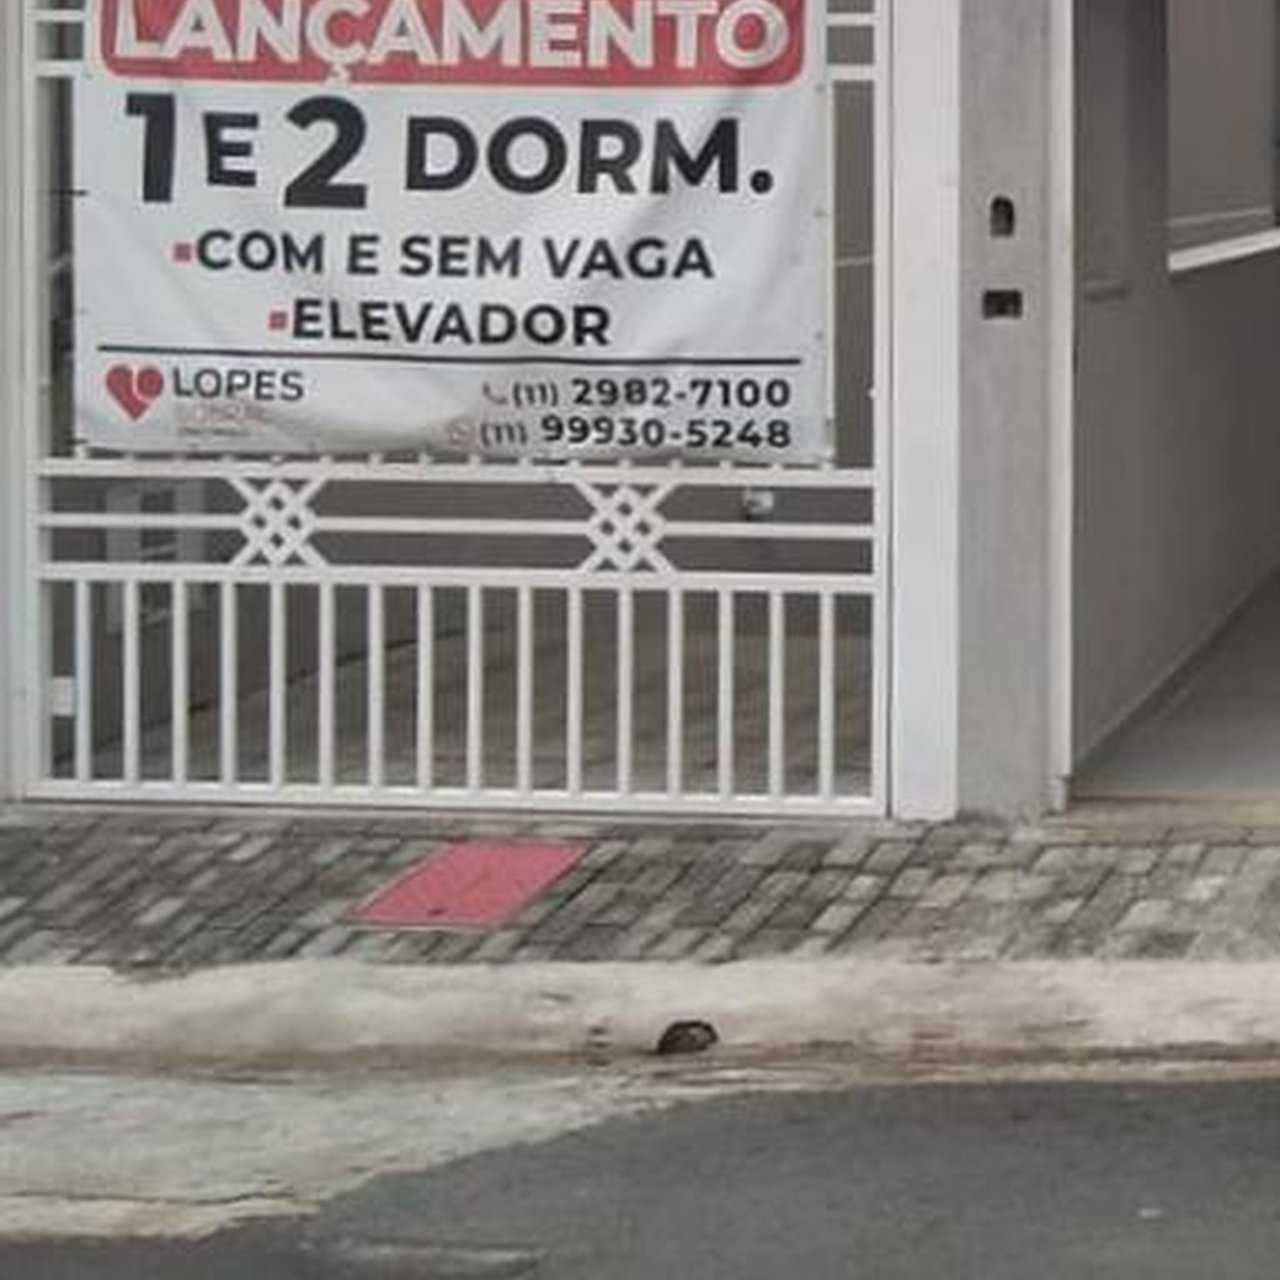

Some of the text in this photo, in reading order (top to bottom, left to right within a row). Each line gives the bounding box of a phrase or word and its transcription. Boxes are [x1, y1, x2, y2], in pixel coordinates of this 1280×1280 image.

[126, 93, 775, 209] 1 E 2 DORM.
[198, 229, 715, 280] COM E SEM VAGA
[291, 298, 612, 347] ELEVADOR
[172, 366, 305, 402] LOPES
[570, 376, 792, 408] 2982-7100
[540, 414, 792, 449] 99930-5248
